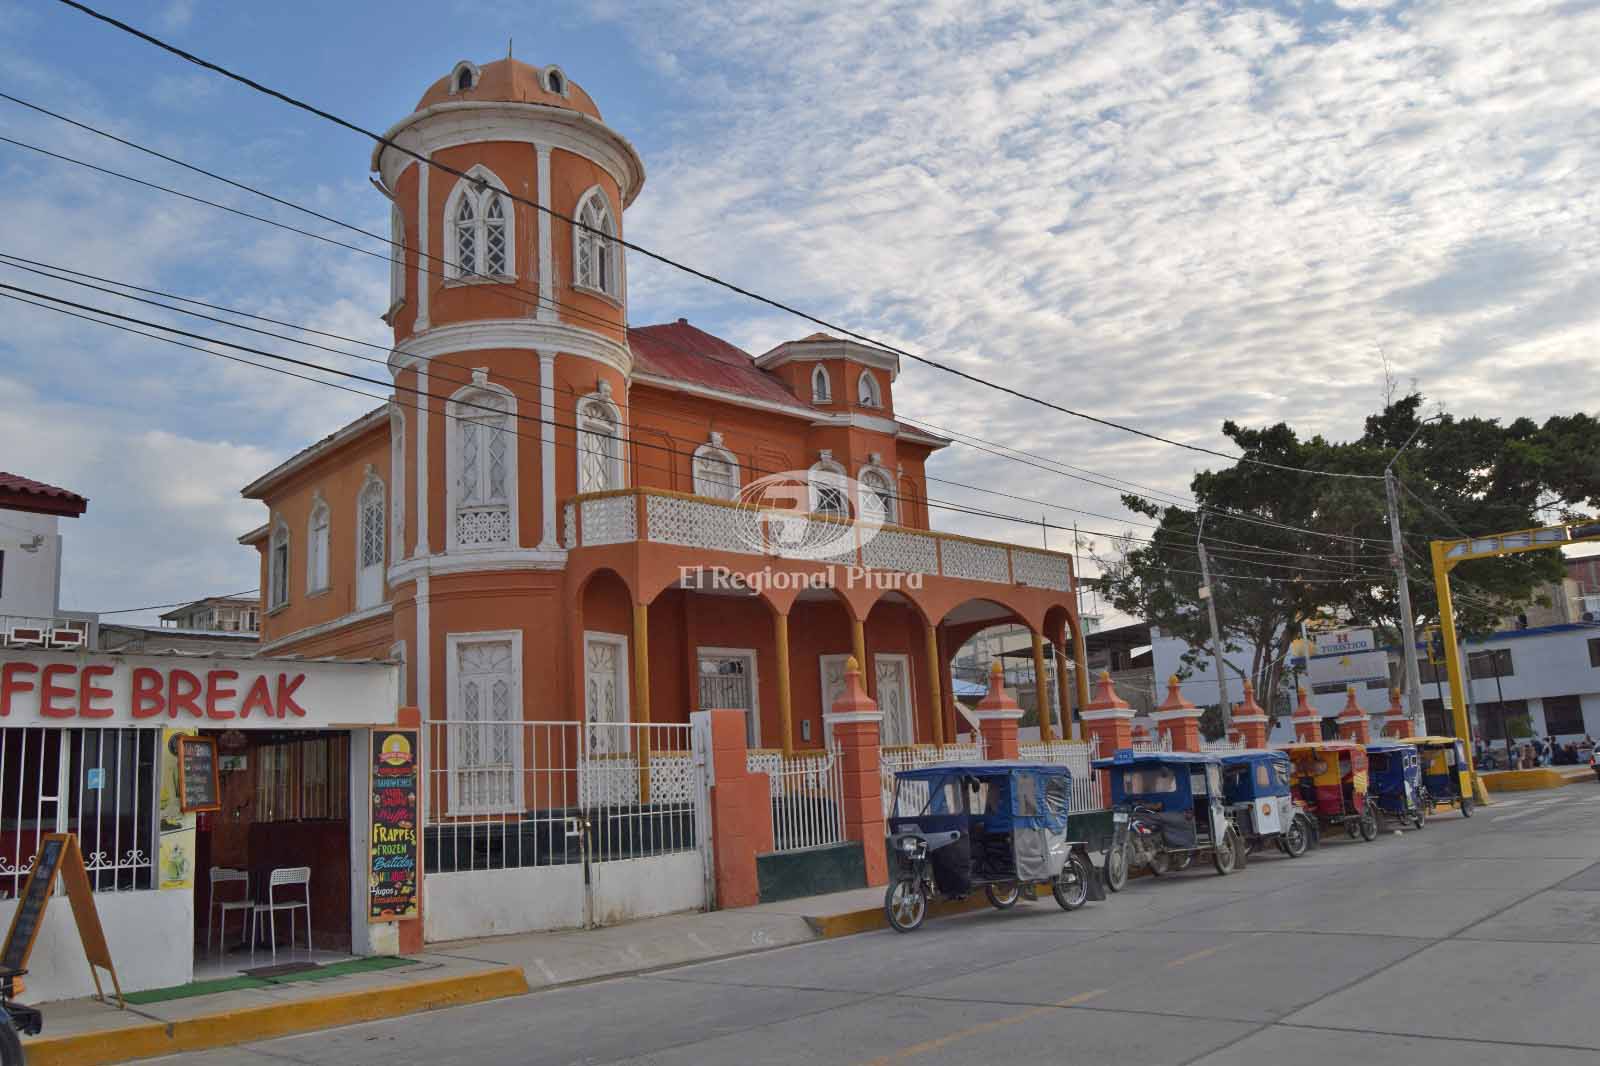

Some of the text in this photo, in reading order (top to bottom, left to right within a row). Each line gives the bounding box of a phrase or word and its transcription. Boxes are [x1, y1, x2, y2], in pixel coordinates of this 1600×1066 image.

[131, 667, 306, 719] BREAK
[373, 823, 416, 843] FRAPPES
[377, 843, 407, 855] FROZEN
